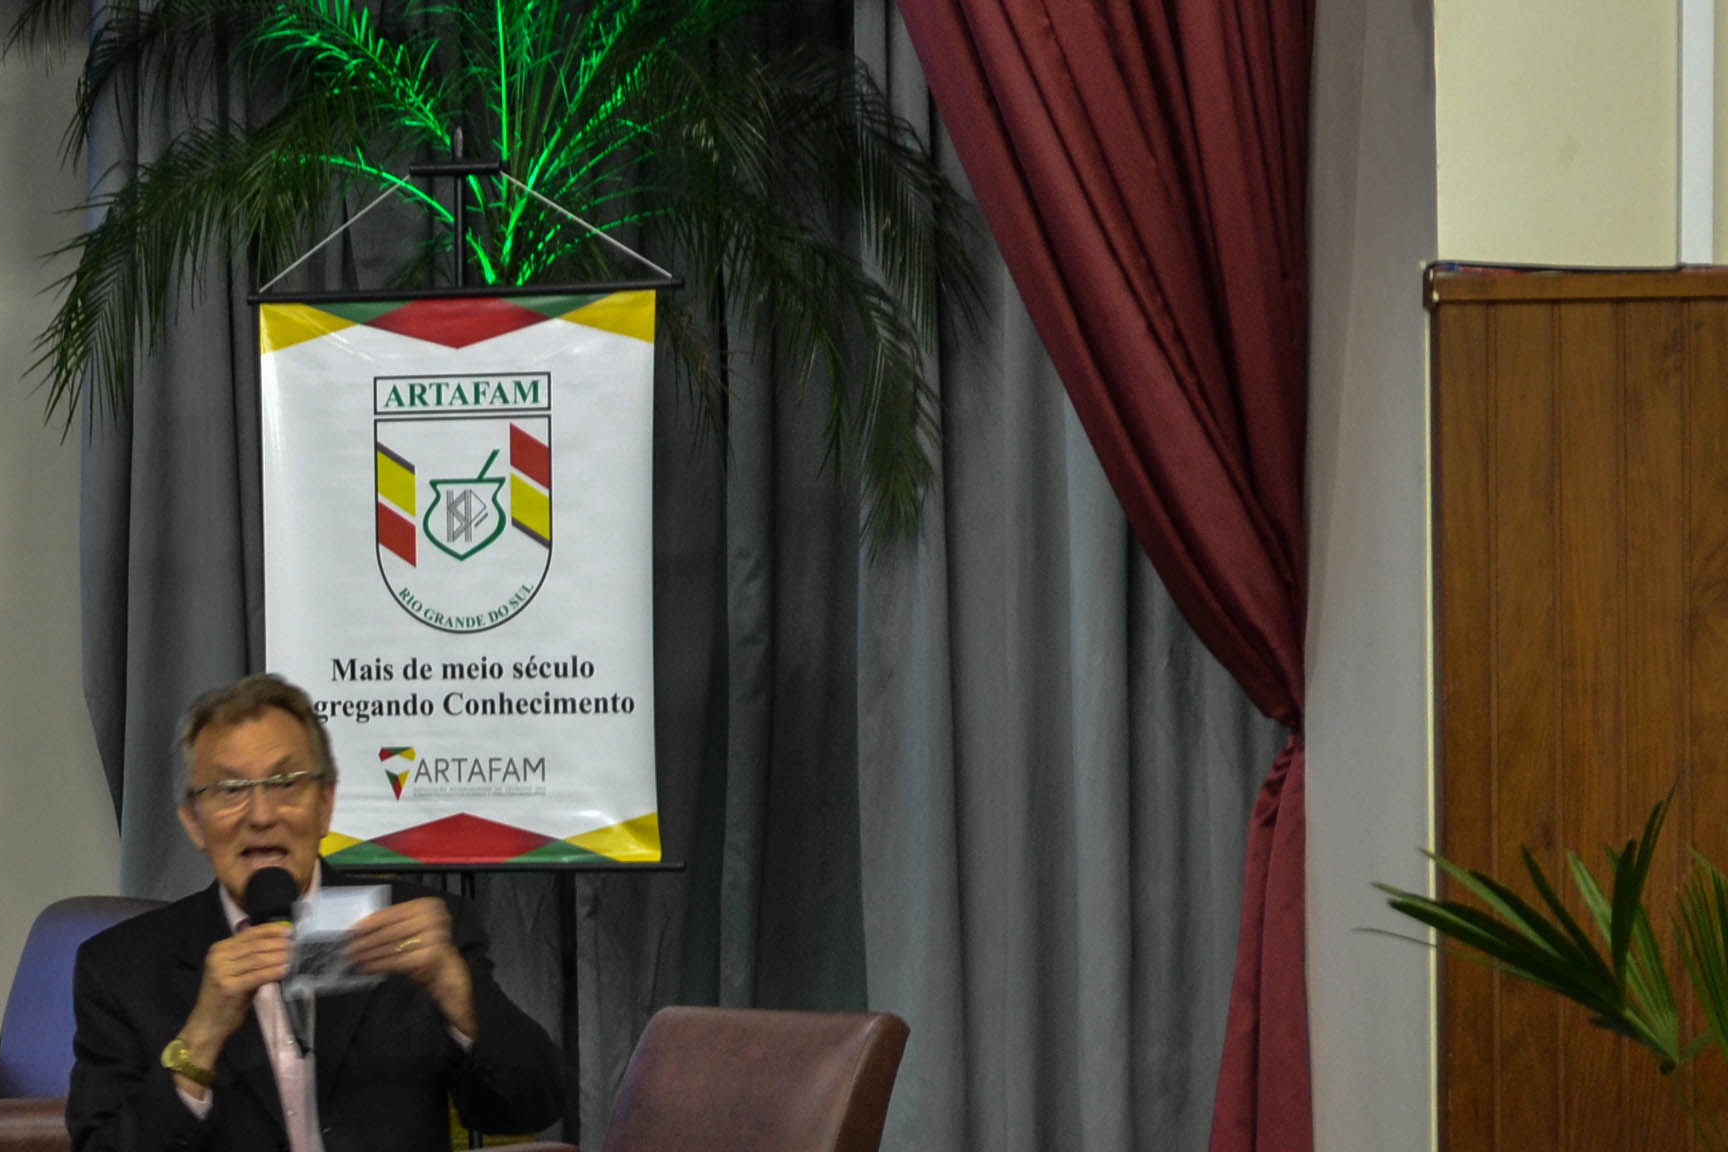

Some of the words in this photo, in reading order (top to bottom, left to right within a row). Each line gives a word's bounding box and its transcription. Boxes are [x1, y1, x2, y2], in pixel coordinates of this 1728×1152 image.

[383, 379, 541, 409] ARTAFAM
[398, 586, 423, 613] RIO
[423, 608, 486, 629] GRANDE
[488, 605, 509, 624] DO
[508, 583, 534, 609] SUL
[331, 657, 394, 682] Mais
[402, 657, 433, 681] de
[442, 656, 504, 681] meio
[512, 655, 595, 680] século
[312, 692, 435, 724] gregando
[442, 691, 635, 717] Conhecimento
[413, 756, 547, 784] ARTAFAM
